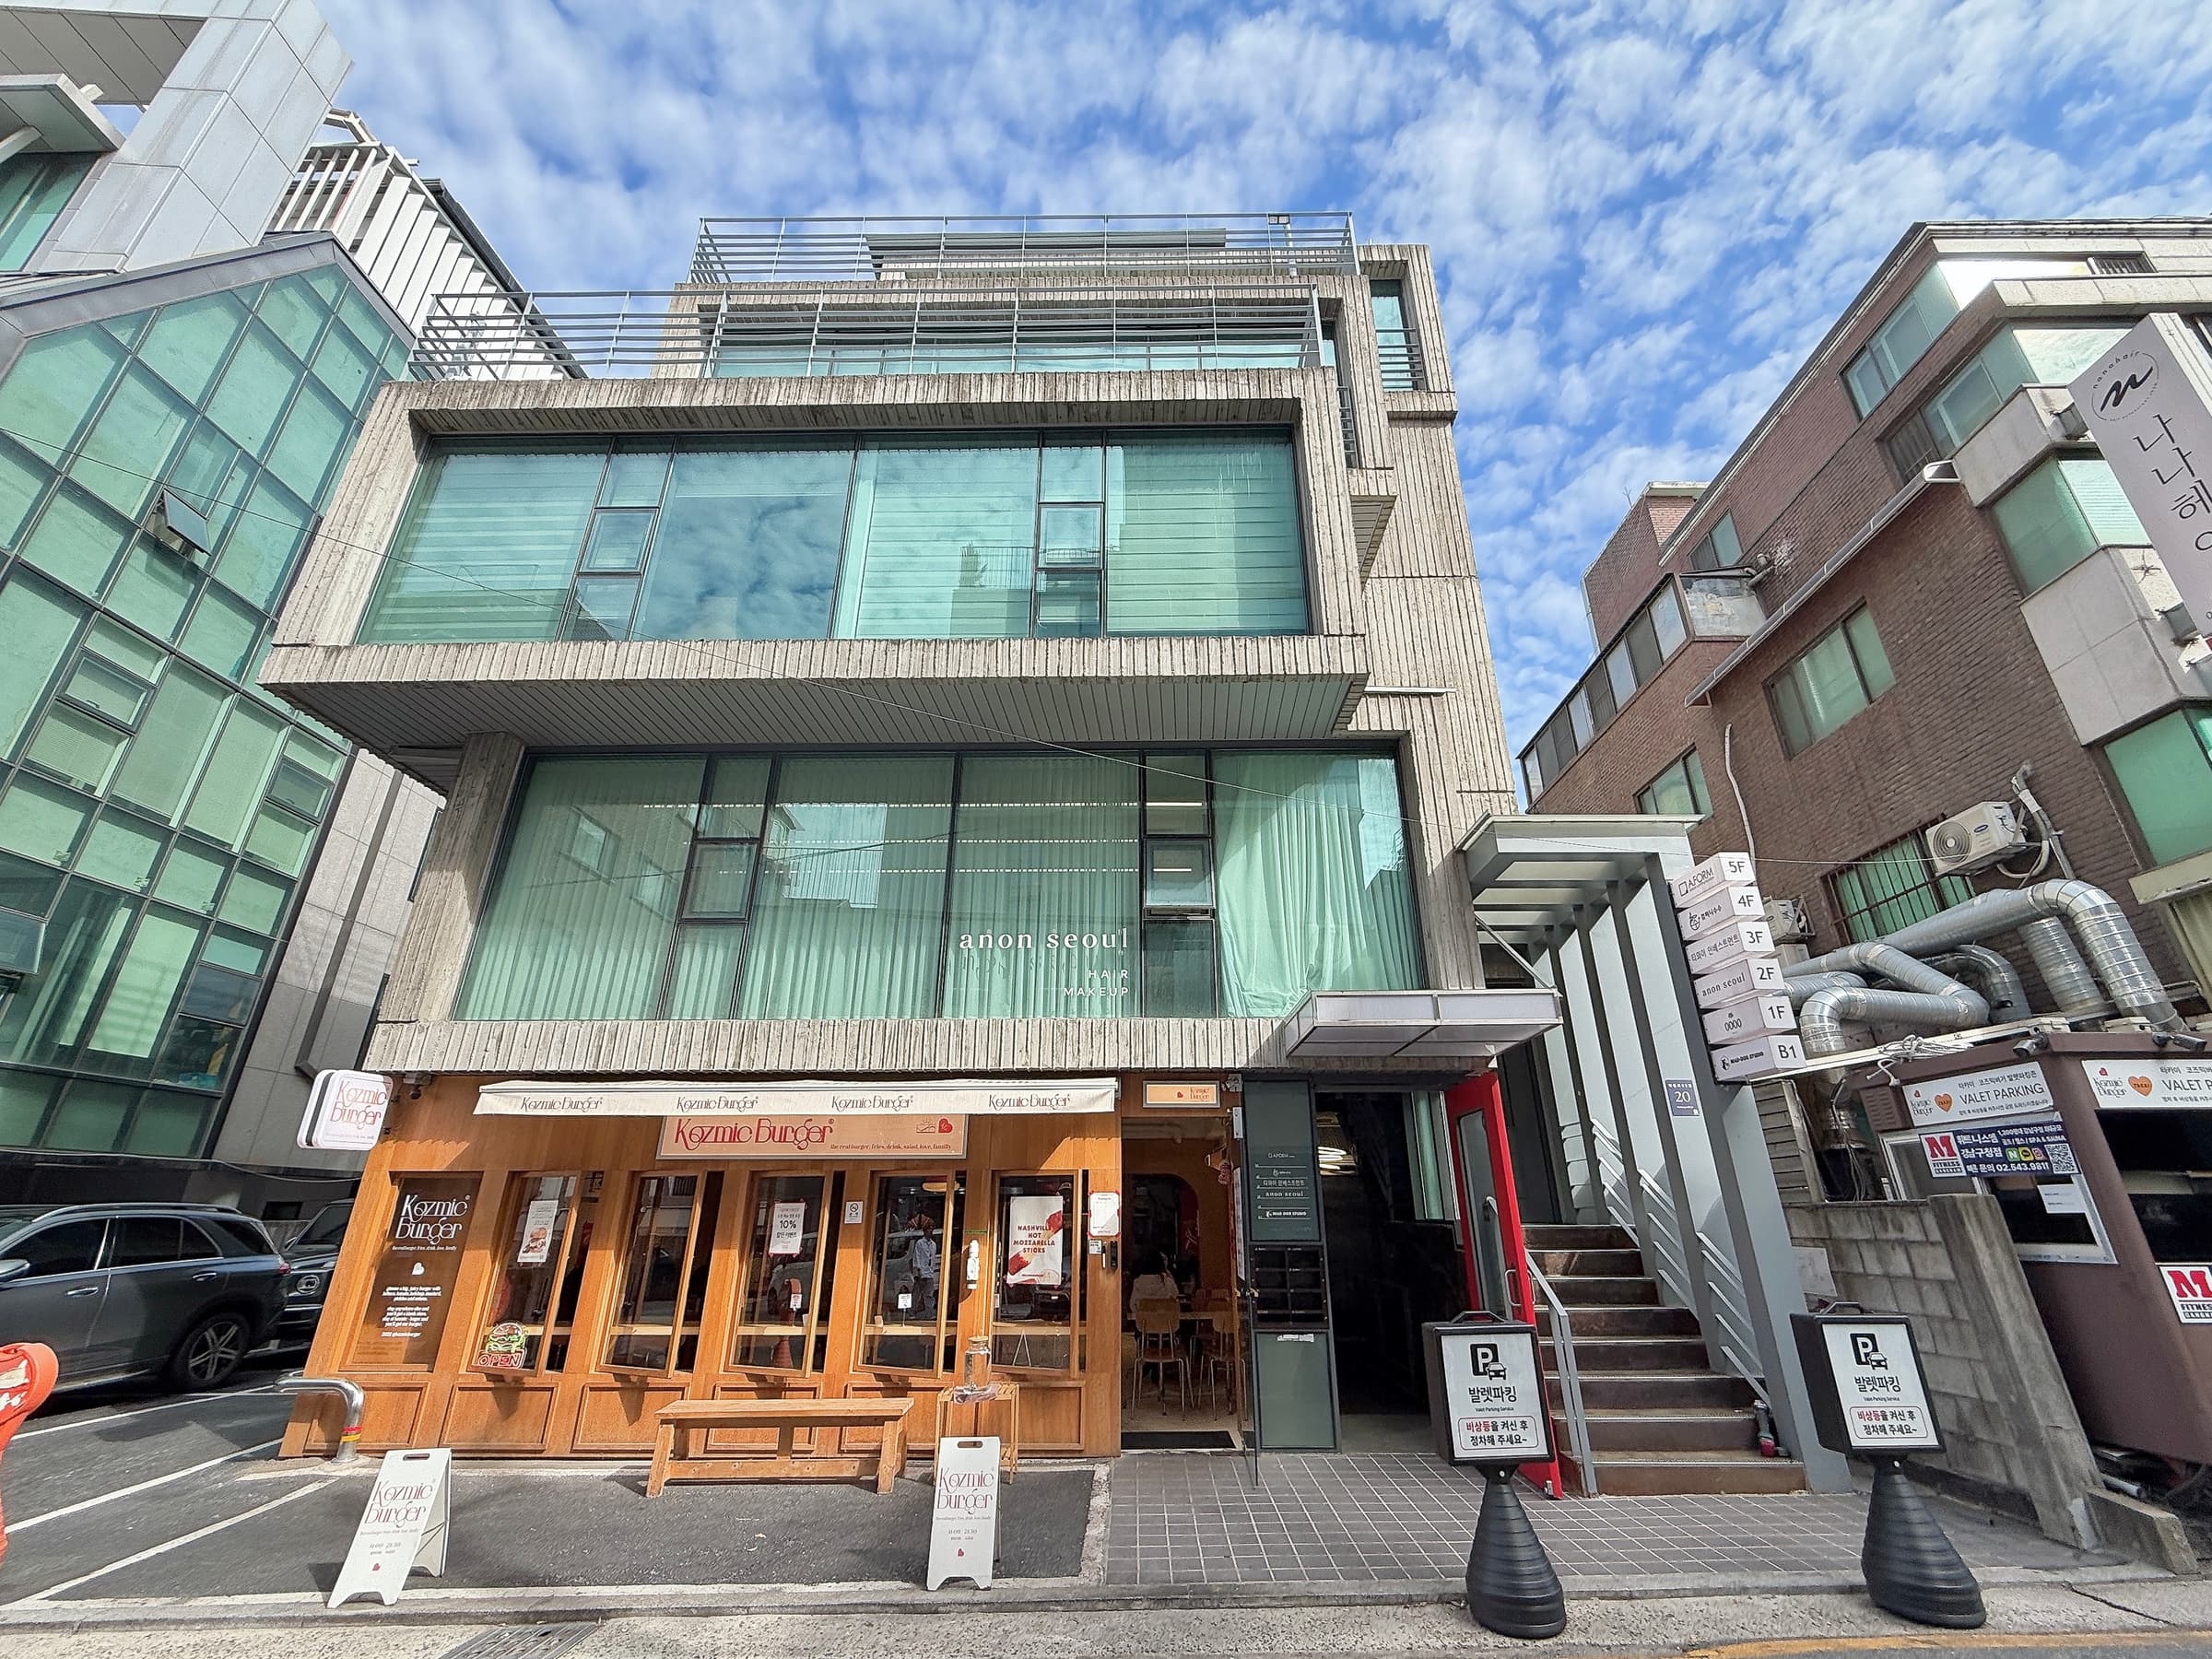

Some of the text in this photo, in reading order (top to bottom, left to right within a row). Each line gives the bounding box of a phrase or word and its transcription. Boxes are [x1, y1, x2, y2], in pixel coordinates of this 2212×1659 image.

[1728, 861, 1745, 873] 5F
[1688, 867, 1714, 888] AFORM
[1737, 895, 1754, 908] 4F
[959, 928, 1129, 949] anon seoul
[1746, 931, 1762, 944] 3F
[1088, 970, 1129, 979] HAIR
[1757, 967, 1774, 980] 2F
[1063, 987, 1129, 996] MAKEUP
[1702, 973, 1746, 996] anon seoul
[1768, 1006, 1784, 1019] 1F
[1778, 1044, 1797, 1059] B1
[2161, 1080, 2202, 1090] VALET
[337, 1080, 387, 1107] Kozmic
[1675, 1091, 1691, 1103] 20
[1959, 1083, 2044, 1104] VALET PARKING
[521, 1097, 561, 1112] Kozmic
[677, 1096, 716, 1112] Kozmic
[831, 1095, 872, 1112] Kozmic
[988, 1093, 1028, 1111] Kozmic
[674, 1118, 833, 1151] Kozmic Burger
[1960, 1147, 2003, 1159] 강남구청점
[401, 1194, 468, 1223] Kozmic
[395, 1217, 463, 1245] Burger
[779, 1219, 797, 1230] 10%
[478, 1354, 520, 1368] OPEN
[1854, 1375, 1901, 1393] 발렛파킹
[1468, 1385, 1517, 1404] 발렛파킹
[1857, 1410, 1916, 1421] 비상등을 켜신 후
[1465, 1420, 1528, 1432] 비상등을 켜신 후
[1863, 1425, 1888, 1436] 정차해
[1470, 1435, 1495, 1446] 정차해
[938, 1467, 994, 1493] Kozmic
[372, 1480, 433, 1507] Kozmic
